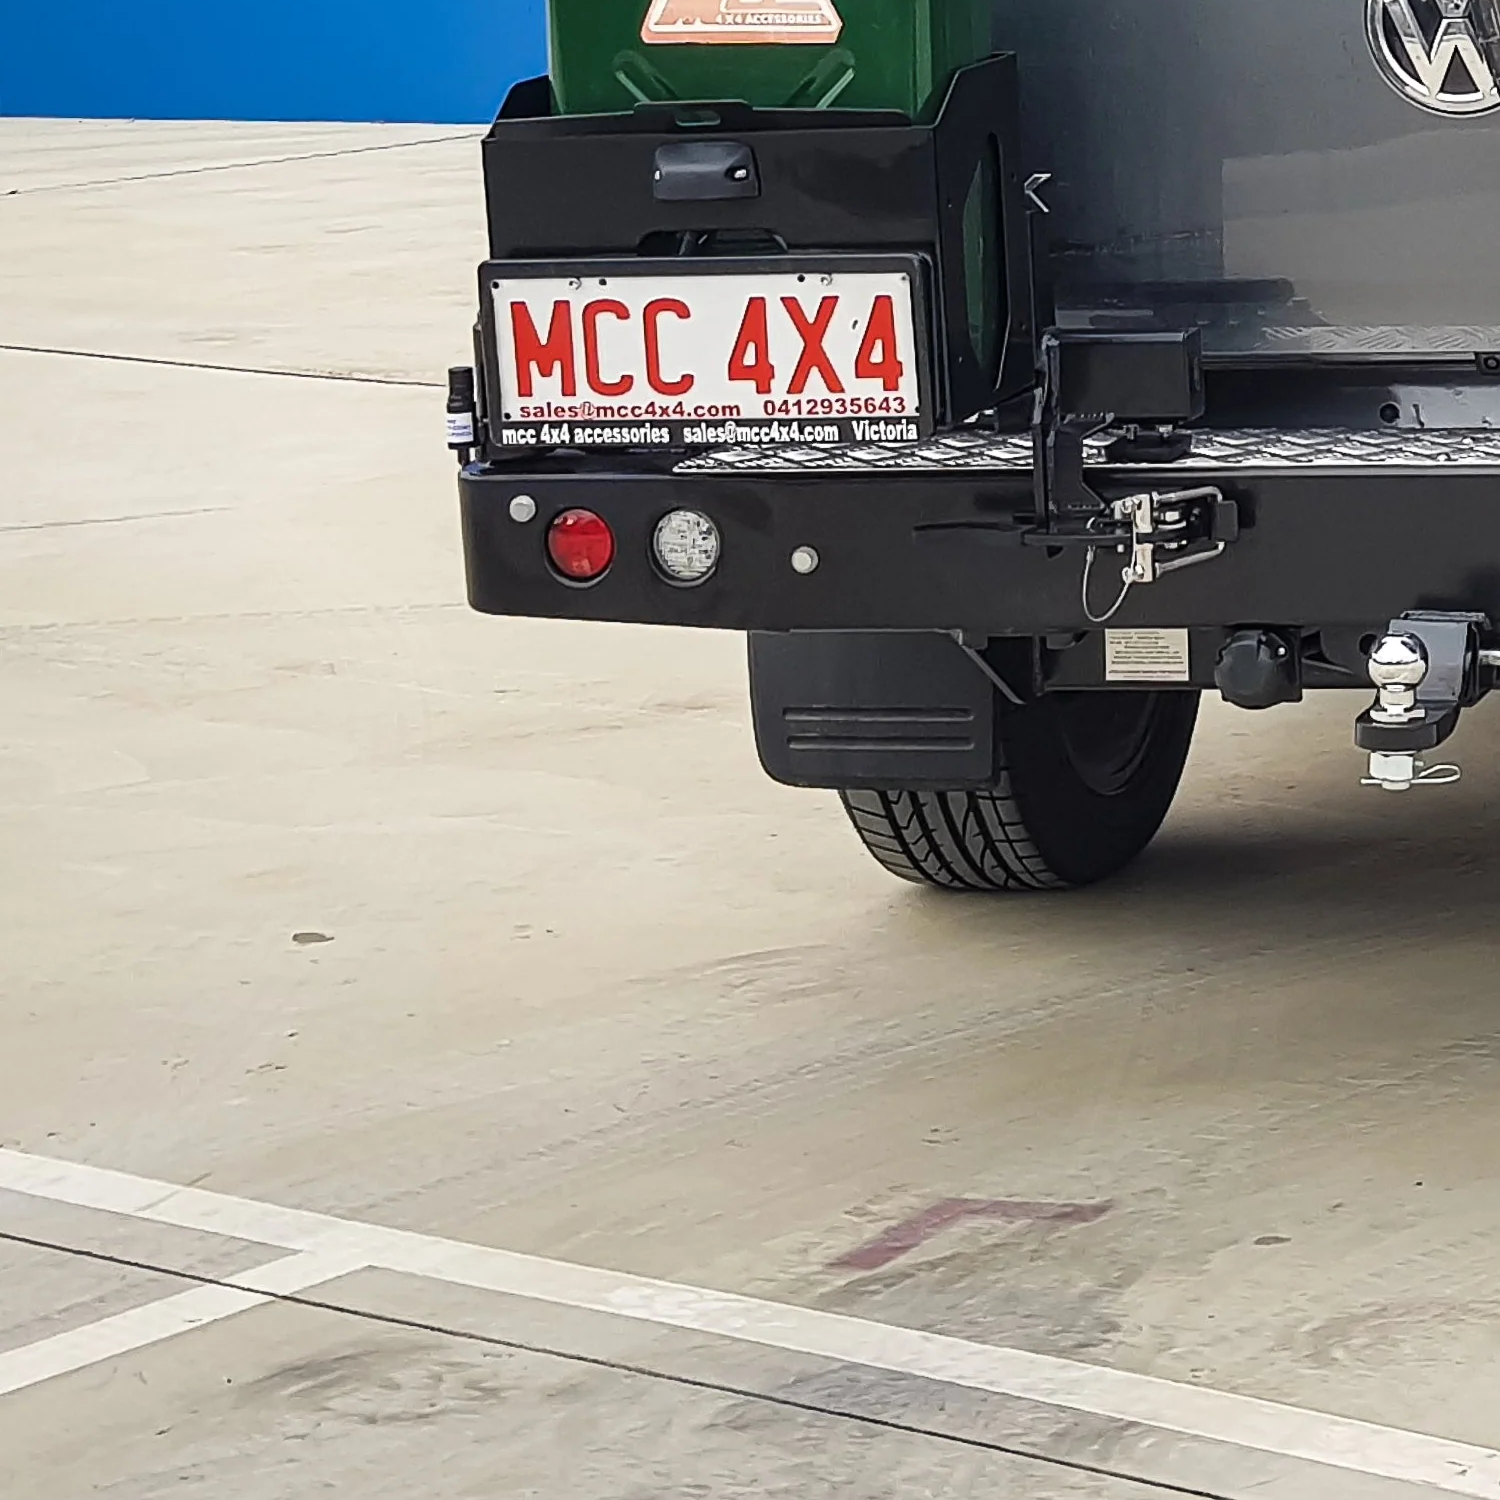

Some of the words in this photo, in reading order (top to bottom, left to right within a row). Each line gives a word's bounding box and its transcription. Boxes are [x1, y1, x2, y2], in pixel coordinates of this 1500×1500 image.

[510, 297, 695, 397] MCC
[728, 295, 904, 395] 4X4
[519, 401, 742, 421] sales@mcc4x4.com
[763, 397, 907, 419] 0412935643
[502, 429, 537, 445] mcc
[539, 424, 571, 445] 4x4
[573, 424, 671, 444] accessories
[683, 421, 839, 444] sales@mcc4x4.com
[851, 419, 918, 442] Victoria
